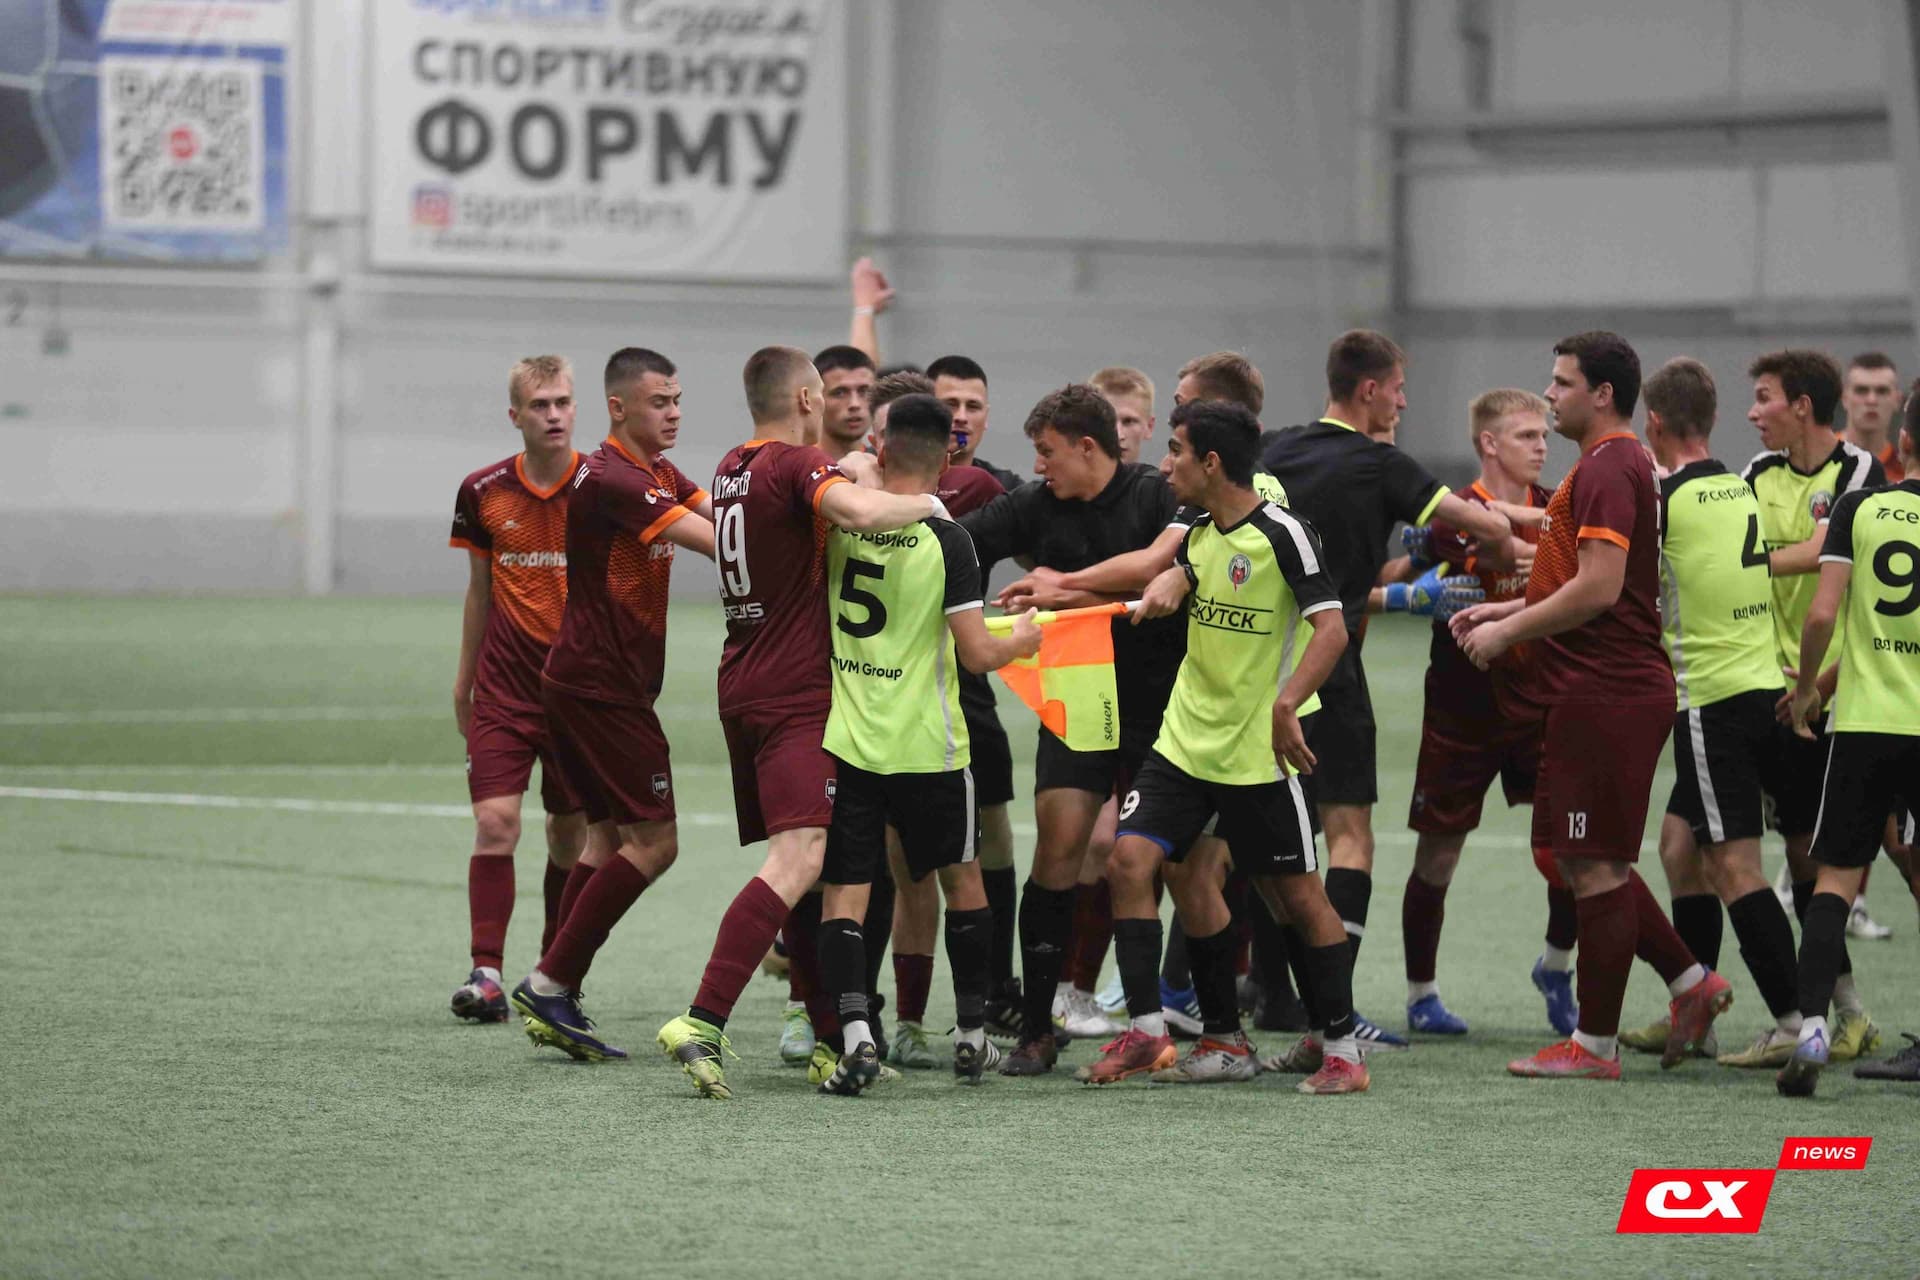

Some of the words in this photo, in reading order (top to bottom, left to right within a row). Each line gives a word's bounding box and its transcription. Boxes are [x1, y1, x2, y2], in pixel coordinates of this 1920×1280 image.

[414, 38, 808, 98] СПОРТИВНУЮ
[414, 101, 801, 190] ФОРМУ
[714, 502, 752, 598] 19
[1741, 513, 1771, 578] 4
[1873, 540, 1920, 617] 9
[836, 557, 887, 639] 5
[862, 662, 903, 680] Group
[1567, 811, 1587, 840] 13
